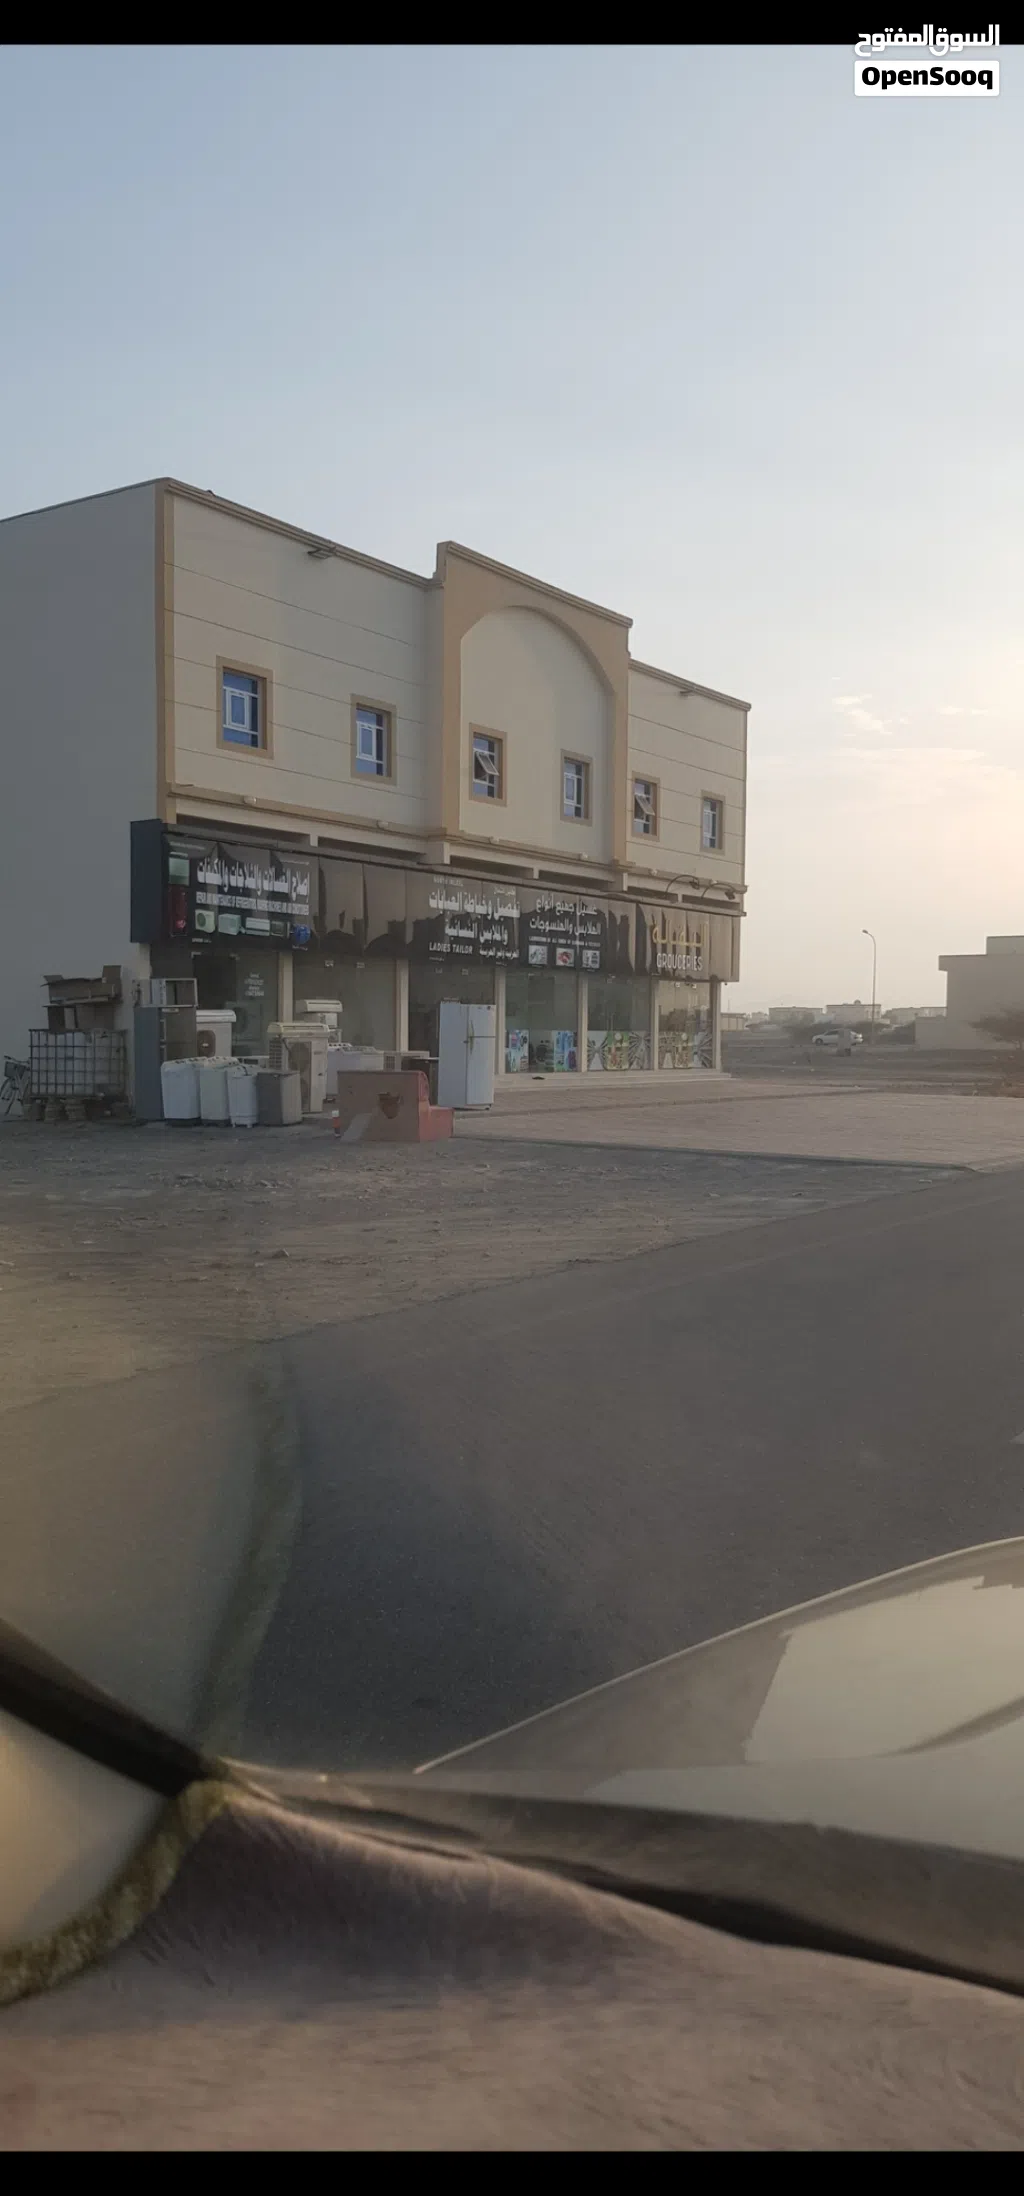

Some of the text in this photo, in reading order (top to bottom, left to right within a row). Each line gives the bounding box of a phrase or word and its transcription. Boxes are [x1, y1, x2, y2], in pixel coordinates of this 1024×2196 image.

[262, 865, 291, 894] الغسالات
[429, 888, 463, 915] العبايات
[463, 892, 492, 920] وخياطة
[493, 897, 521, 921] تفصيل
[555, 900, 574, 916] جميع
[576, 900, 598, 917] غسيل
[479, 923, 508, 945] والملابس
[529, 916, 602, 937] الملابس والمنسوجات
[429, 941, 473, 955] LADIES TAILOR
[656, 953, 703, 971] GROUCERIES
